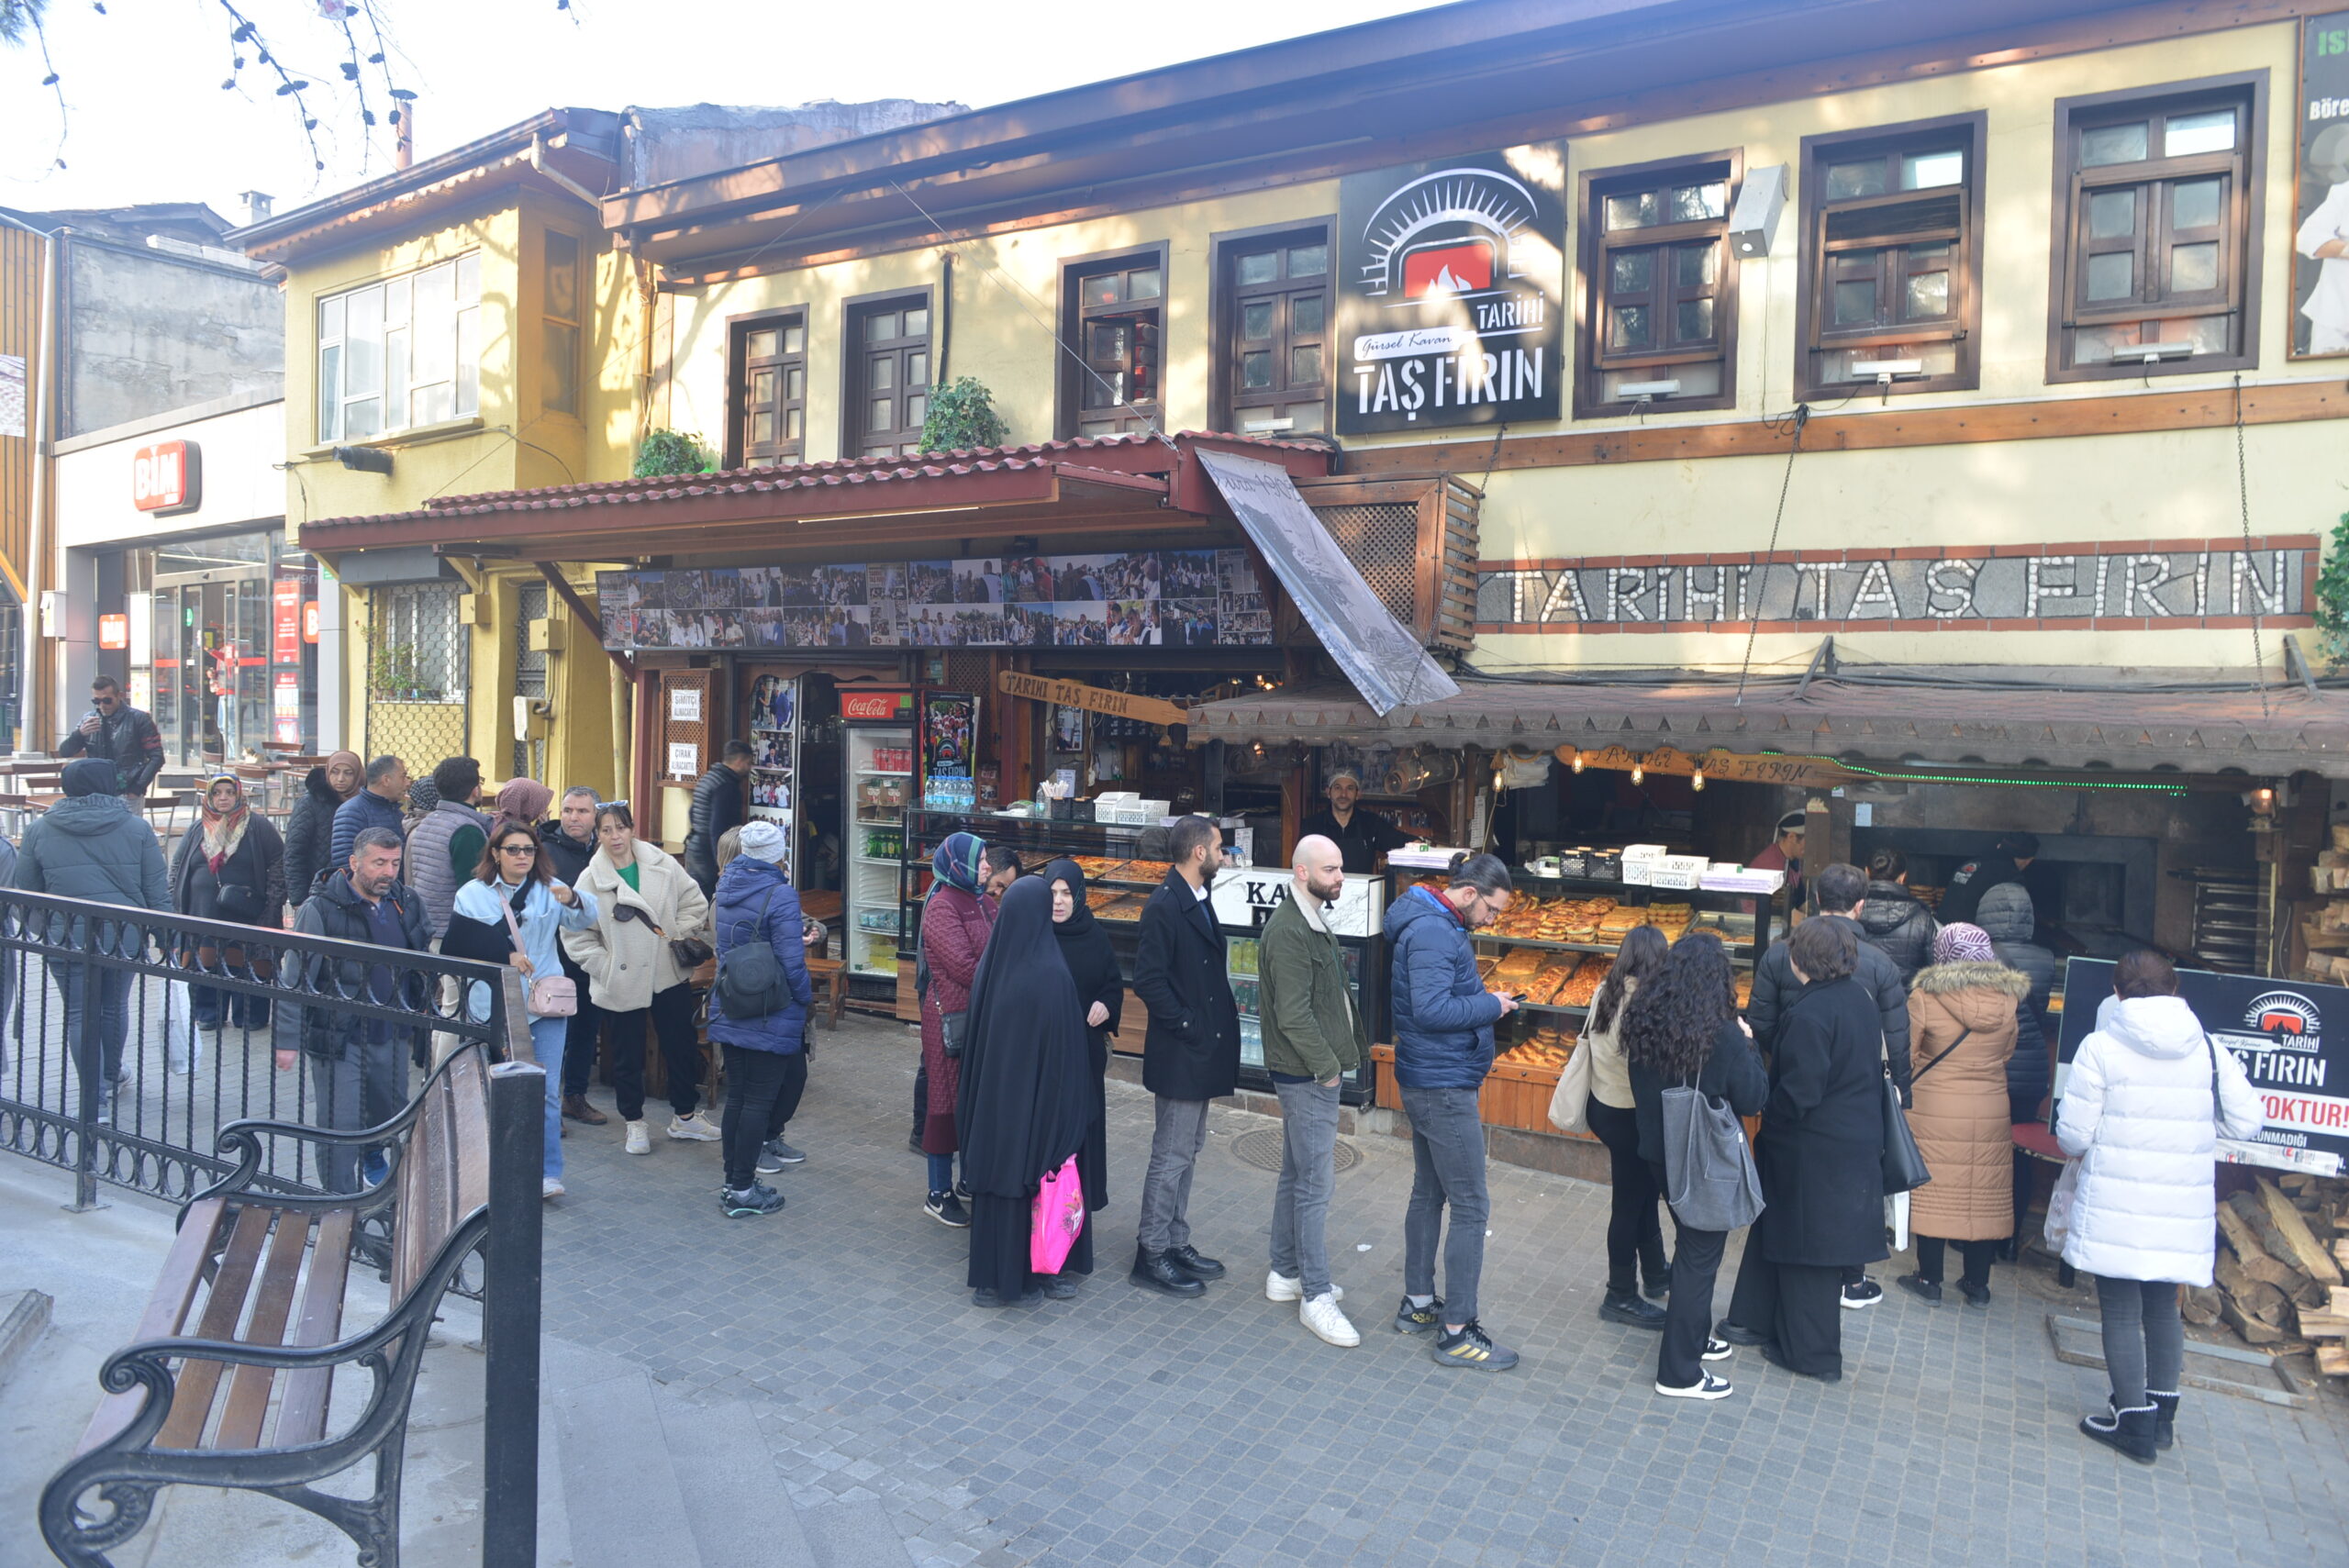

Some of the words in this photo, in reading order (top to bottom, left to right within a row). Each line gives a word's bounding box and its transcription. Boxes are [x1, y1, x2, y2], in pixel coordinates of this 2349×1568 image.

[2319, 29, 2349, 56] IS
[1477, 291, 1544, 329] TARİHİ
[1363, 335, 1405, 358] Gürsel
[1409, 331, 1453, 347] Kavan
[1353, 359, 1425, 421] TAŞ
[1435, 347, 1543, 407] FIRIN
[2026, 550, 2285, 617] FIRIN
[1088, 690, 1130, 714] FIRIN
[2281, 1034, 2321, 1051] TARİHİ
[2254, 1051, 2326, 1086] FIRIN
[2251, 1130, 2308, 1148] UNMADIĞI
